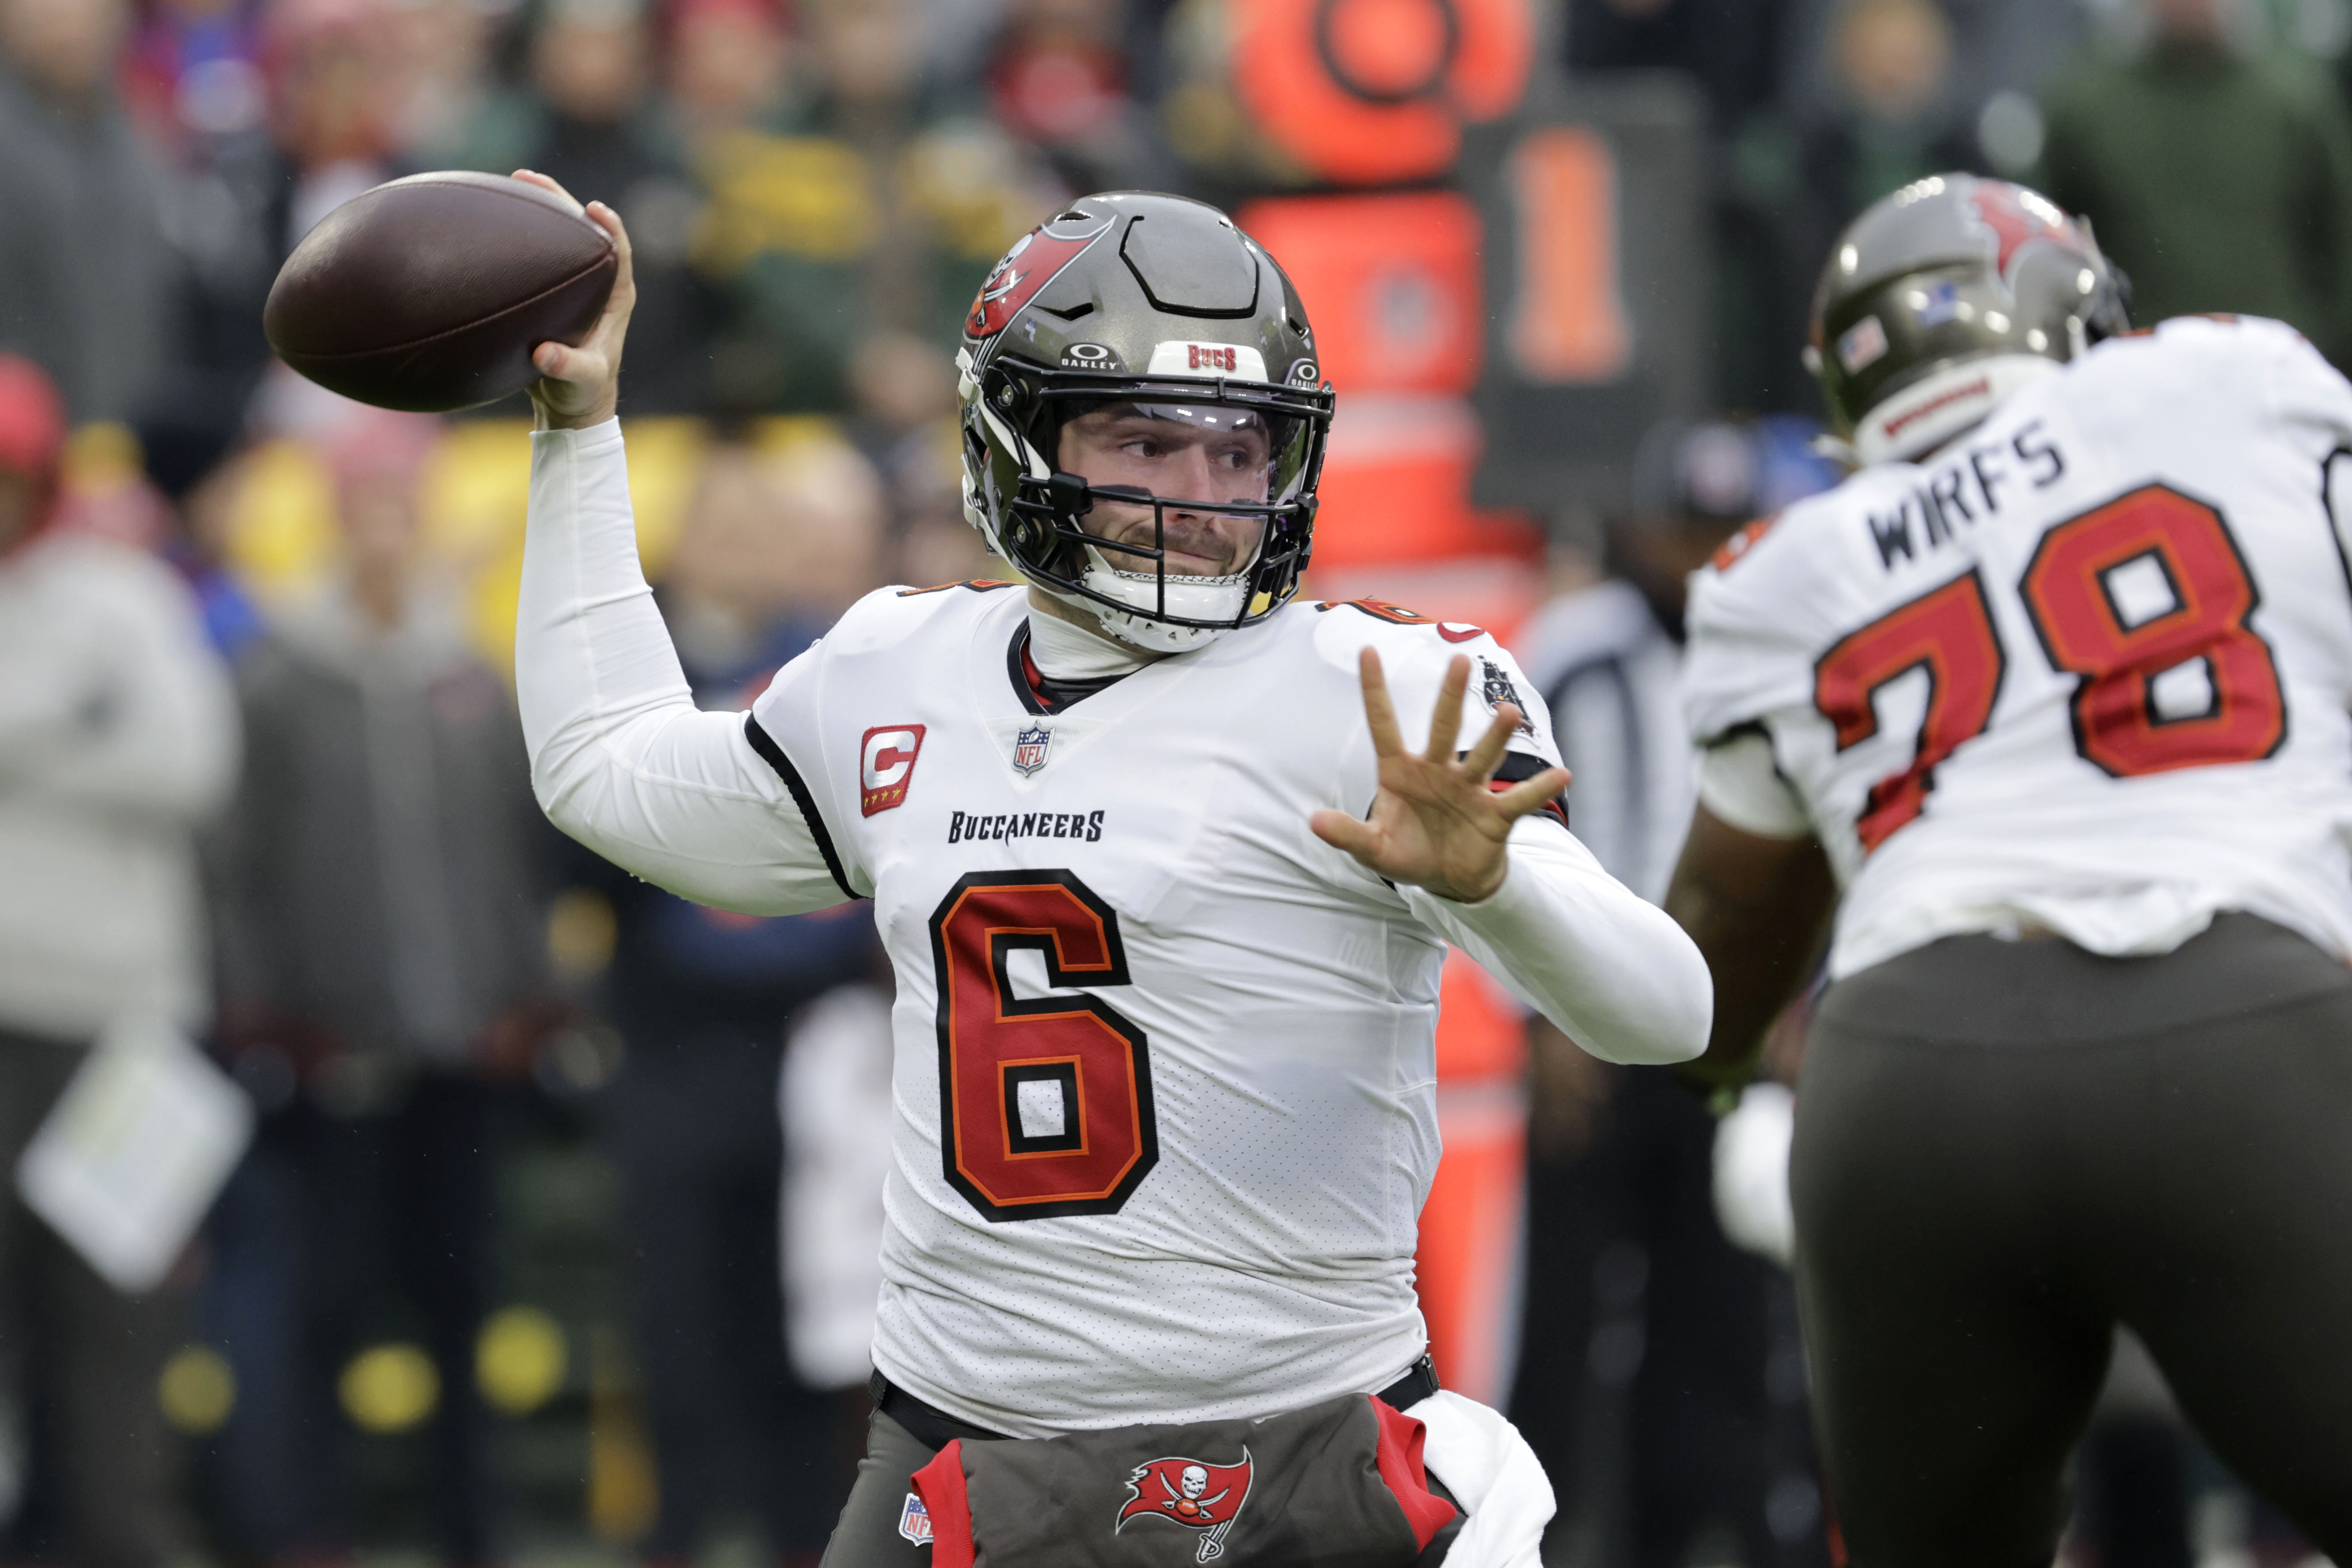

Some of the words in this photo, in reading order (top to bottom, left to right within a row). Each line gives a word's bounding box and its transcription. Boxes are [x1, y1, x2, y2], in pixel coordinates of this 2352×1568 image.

[1062, 358, 1117, 369] OAKLEY
[1187, 345, 1235, 370] BUCS
[1292, 379, 1318, 389] OAKLEY
[1868, 417, 2065, 569] WIRFS
[1814, 476, 2288, 856] 78
[863, 730, 916, 791] C
[1016, 746, 1042, 766] NFL
[948, 810, 1105, 847] BUCCANEERS
[929, 868, 1160, 1223] 6
